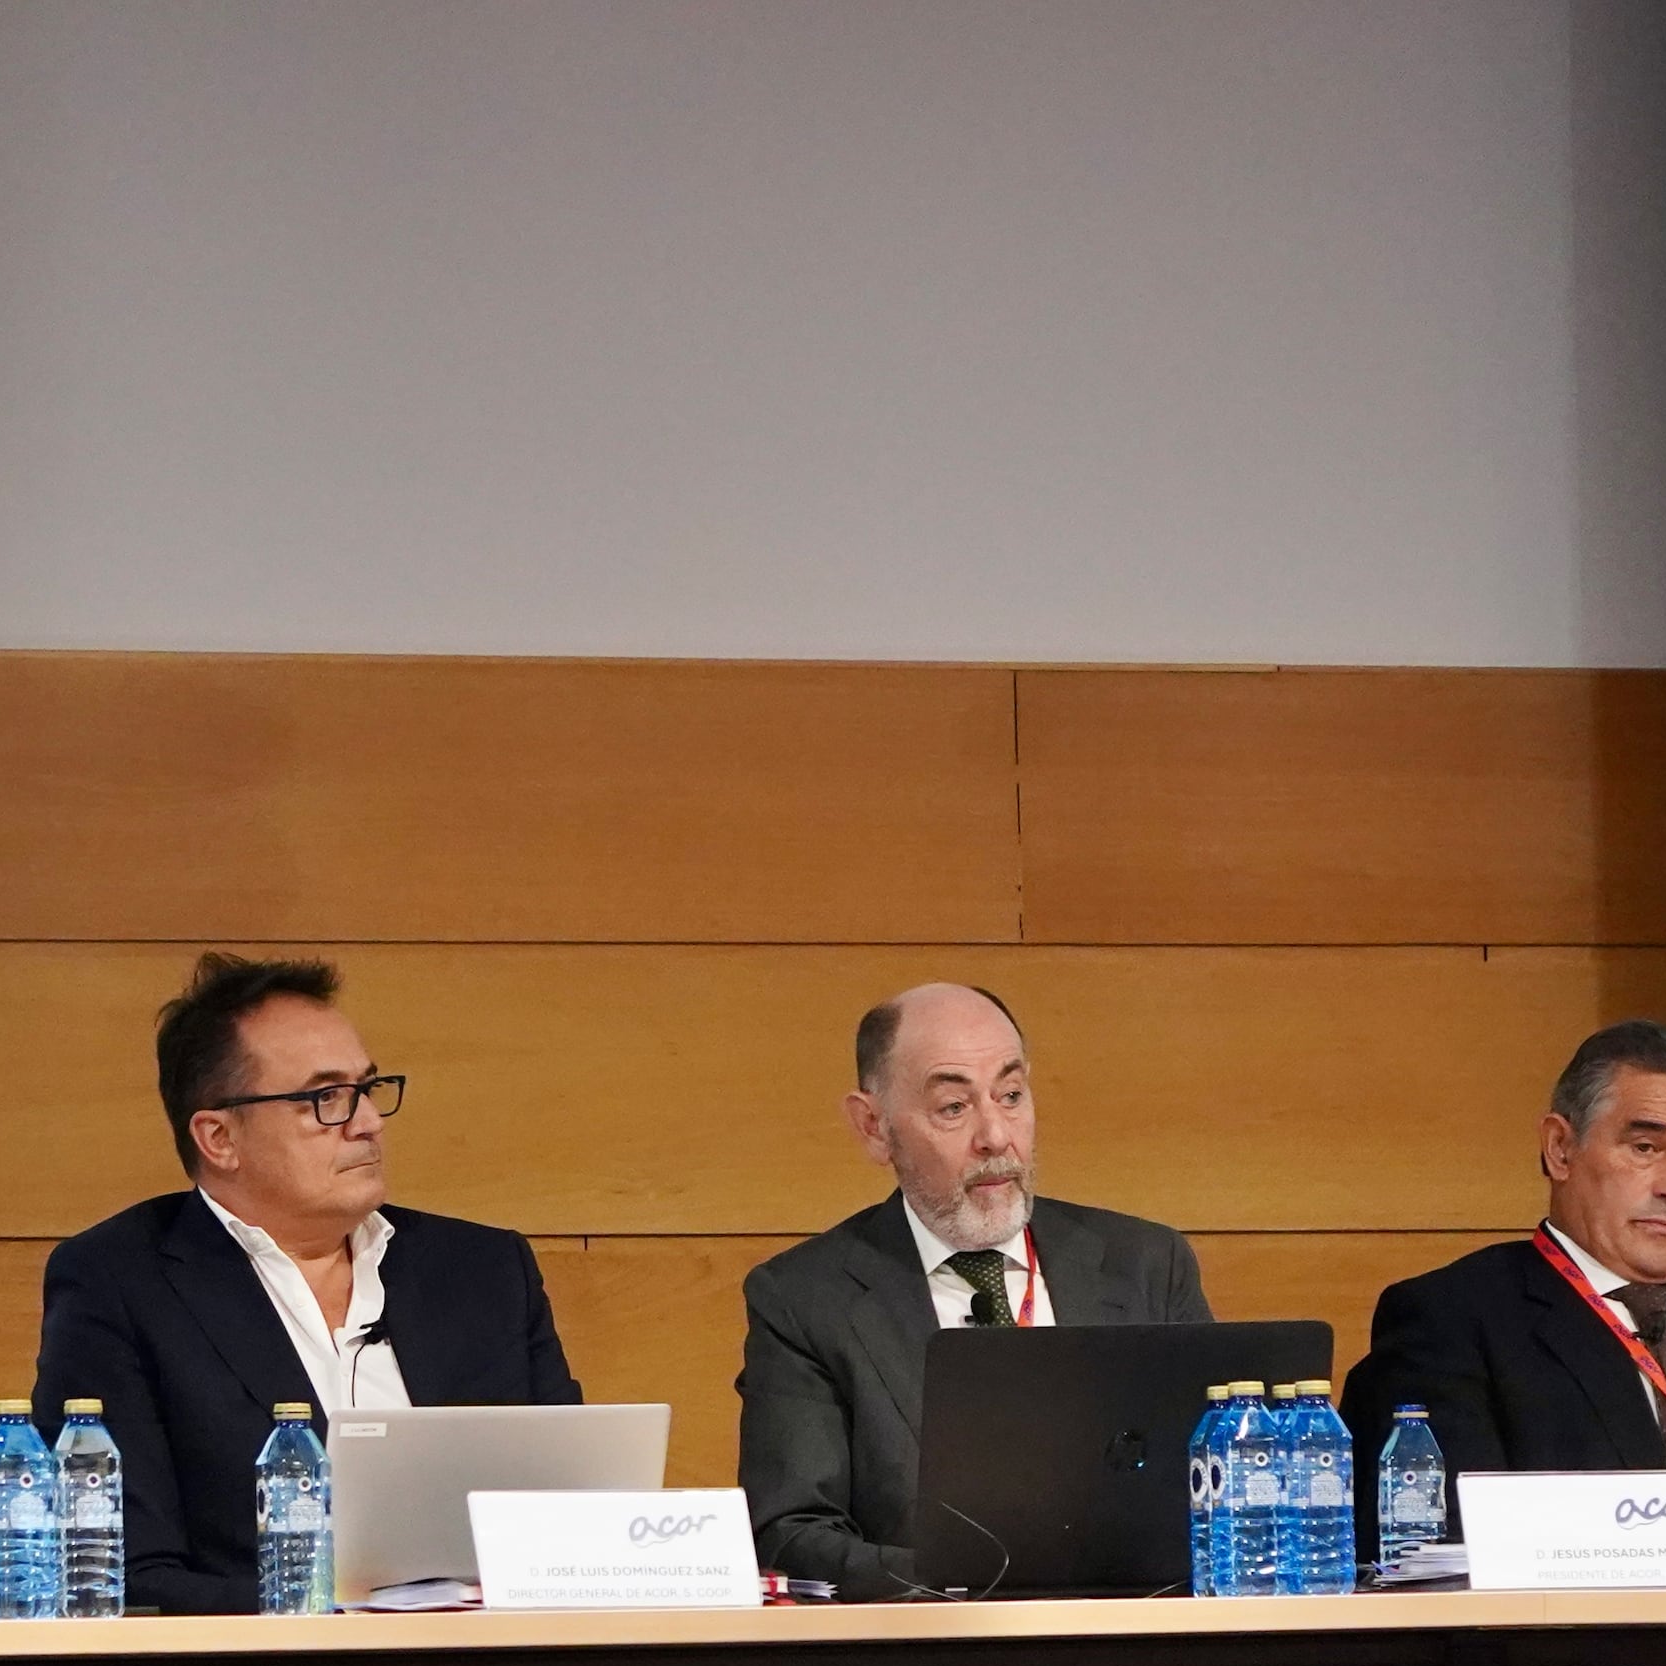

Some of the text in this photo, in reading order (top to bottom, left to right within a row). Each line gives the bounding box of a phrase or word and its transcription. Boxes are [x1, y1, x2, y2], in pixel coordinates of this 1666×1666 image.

[629, 1514, 717, 1545] acor
[1551, 1546, 1591, 1559] JESÚS
[1594, 1548, 1655, 1559] POSADAS
[546, 1564, 577, 1577] JOSÉ
[580, 1566, 610, 1577] LUIS
[612, 1564, 693, 1577] DOMÍNGUEZ
[696, 1566, 731, 1576] SANZ
[508, 1588, 567, 1600] DIRECTOR
[569, 1588, 623, 1599] GENERAL
[626, 1588, 641, 1598] DE
